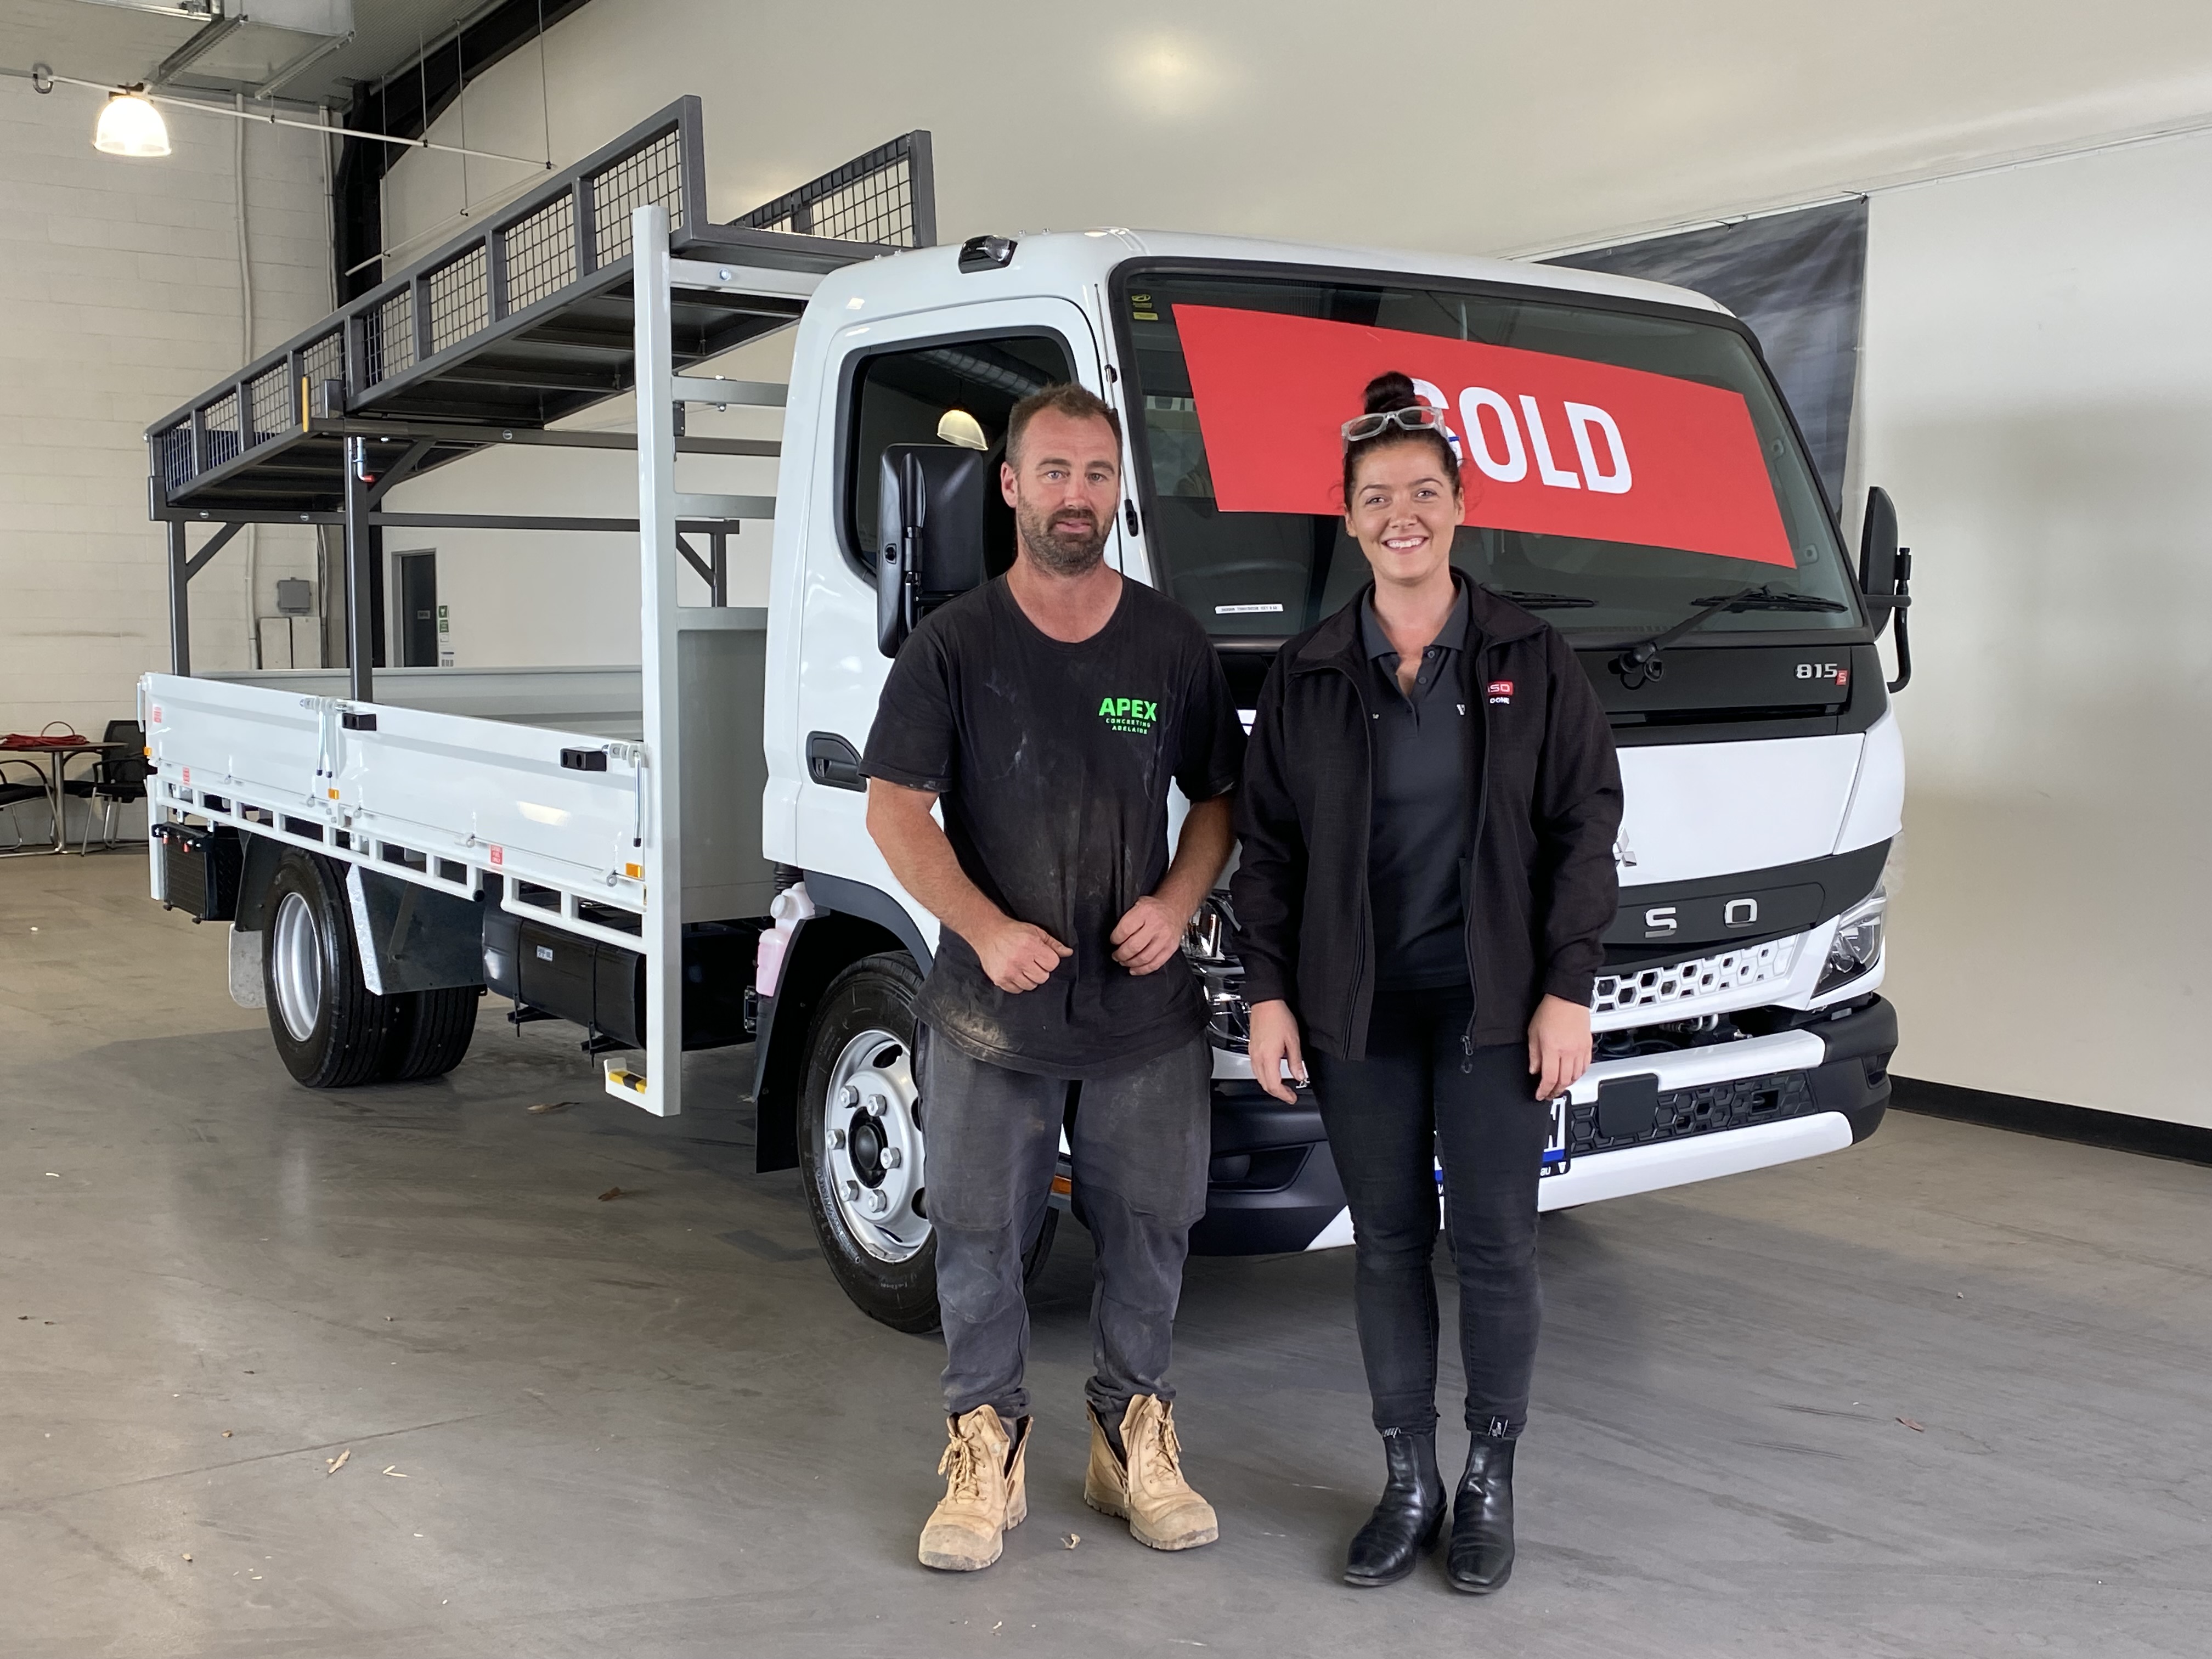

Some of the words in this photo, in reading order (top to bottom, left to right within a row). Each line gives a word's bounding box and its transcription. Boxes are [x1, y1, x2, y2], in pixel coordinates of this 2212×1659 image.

[1796, 663, 1838, 679] 815
[1098, 697, 1158, 721] APEX
[1105, 718, 1151, 728] CONCRETING
[1111, 725, 1148, 735] ADELAIDE
